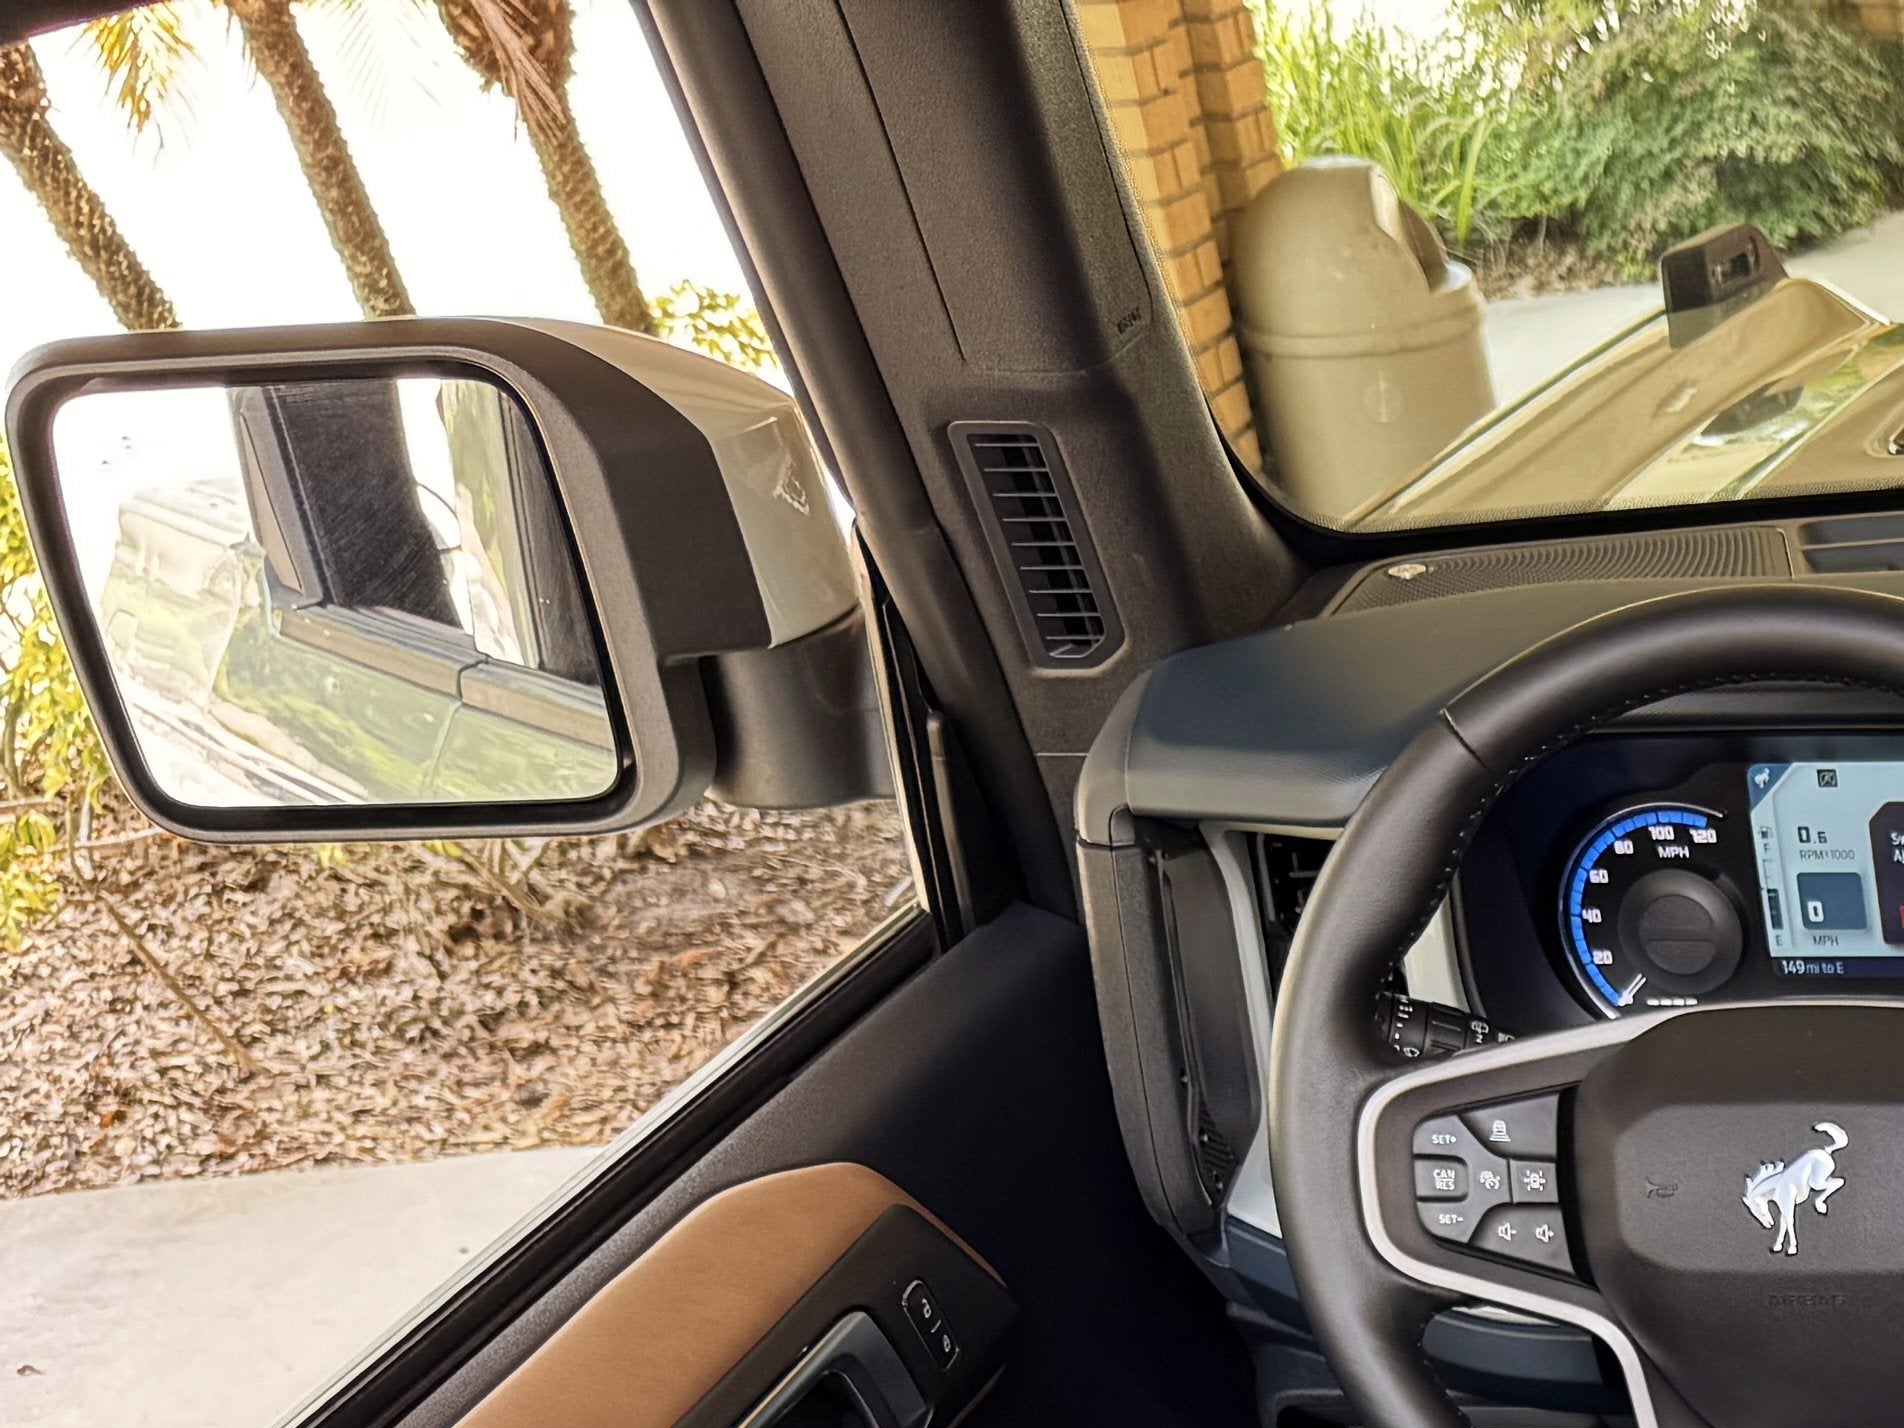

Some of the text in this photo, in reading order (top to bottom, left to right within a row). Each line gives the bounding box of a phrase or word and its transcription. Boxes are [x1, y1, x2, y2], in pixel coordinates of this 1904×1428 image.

[1649, 826, 1674, 840] 100
[1690, 829, 1717, 843] 120
[1614, 840, 1634, 854] 80
[1657, 846, 1690, 859] MPH
[1589, 869, 1609, 883] 60
[1582, 909, 1602, 923] 40
[1807, 900, 1824, 922] 0
[1812, 935, 1840, 947] MPH
[1592, 950, 1613, 965] 20
[1836, 961, 1845, 974] E
